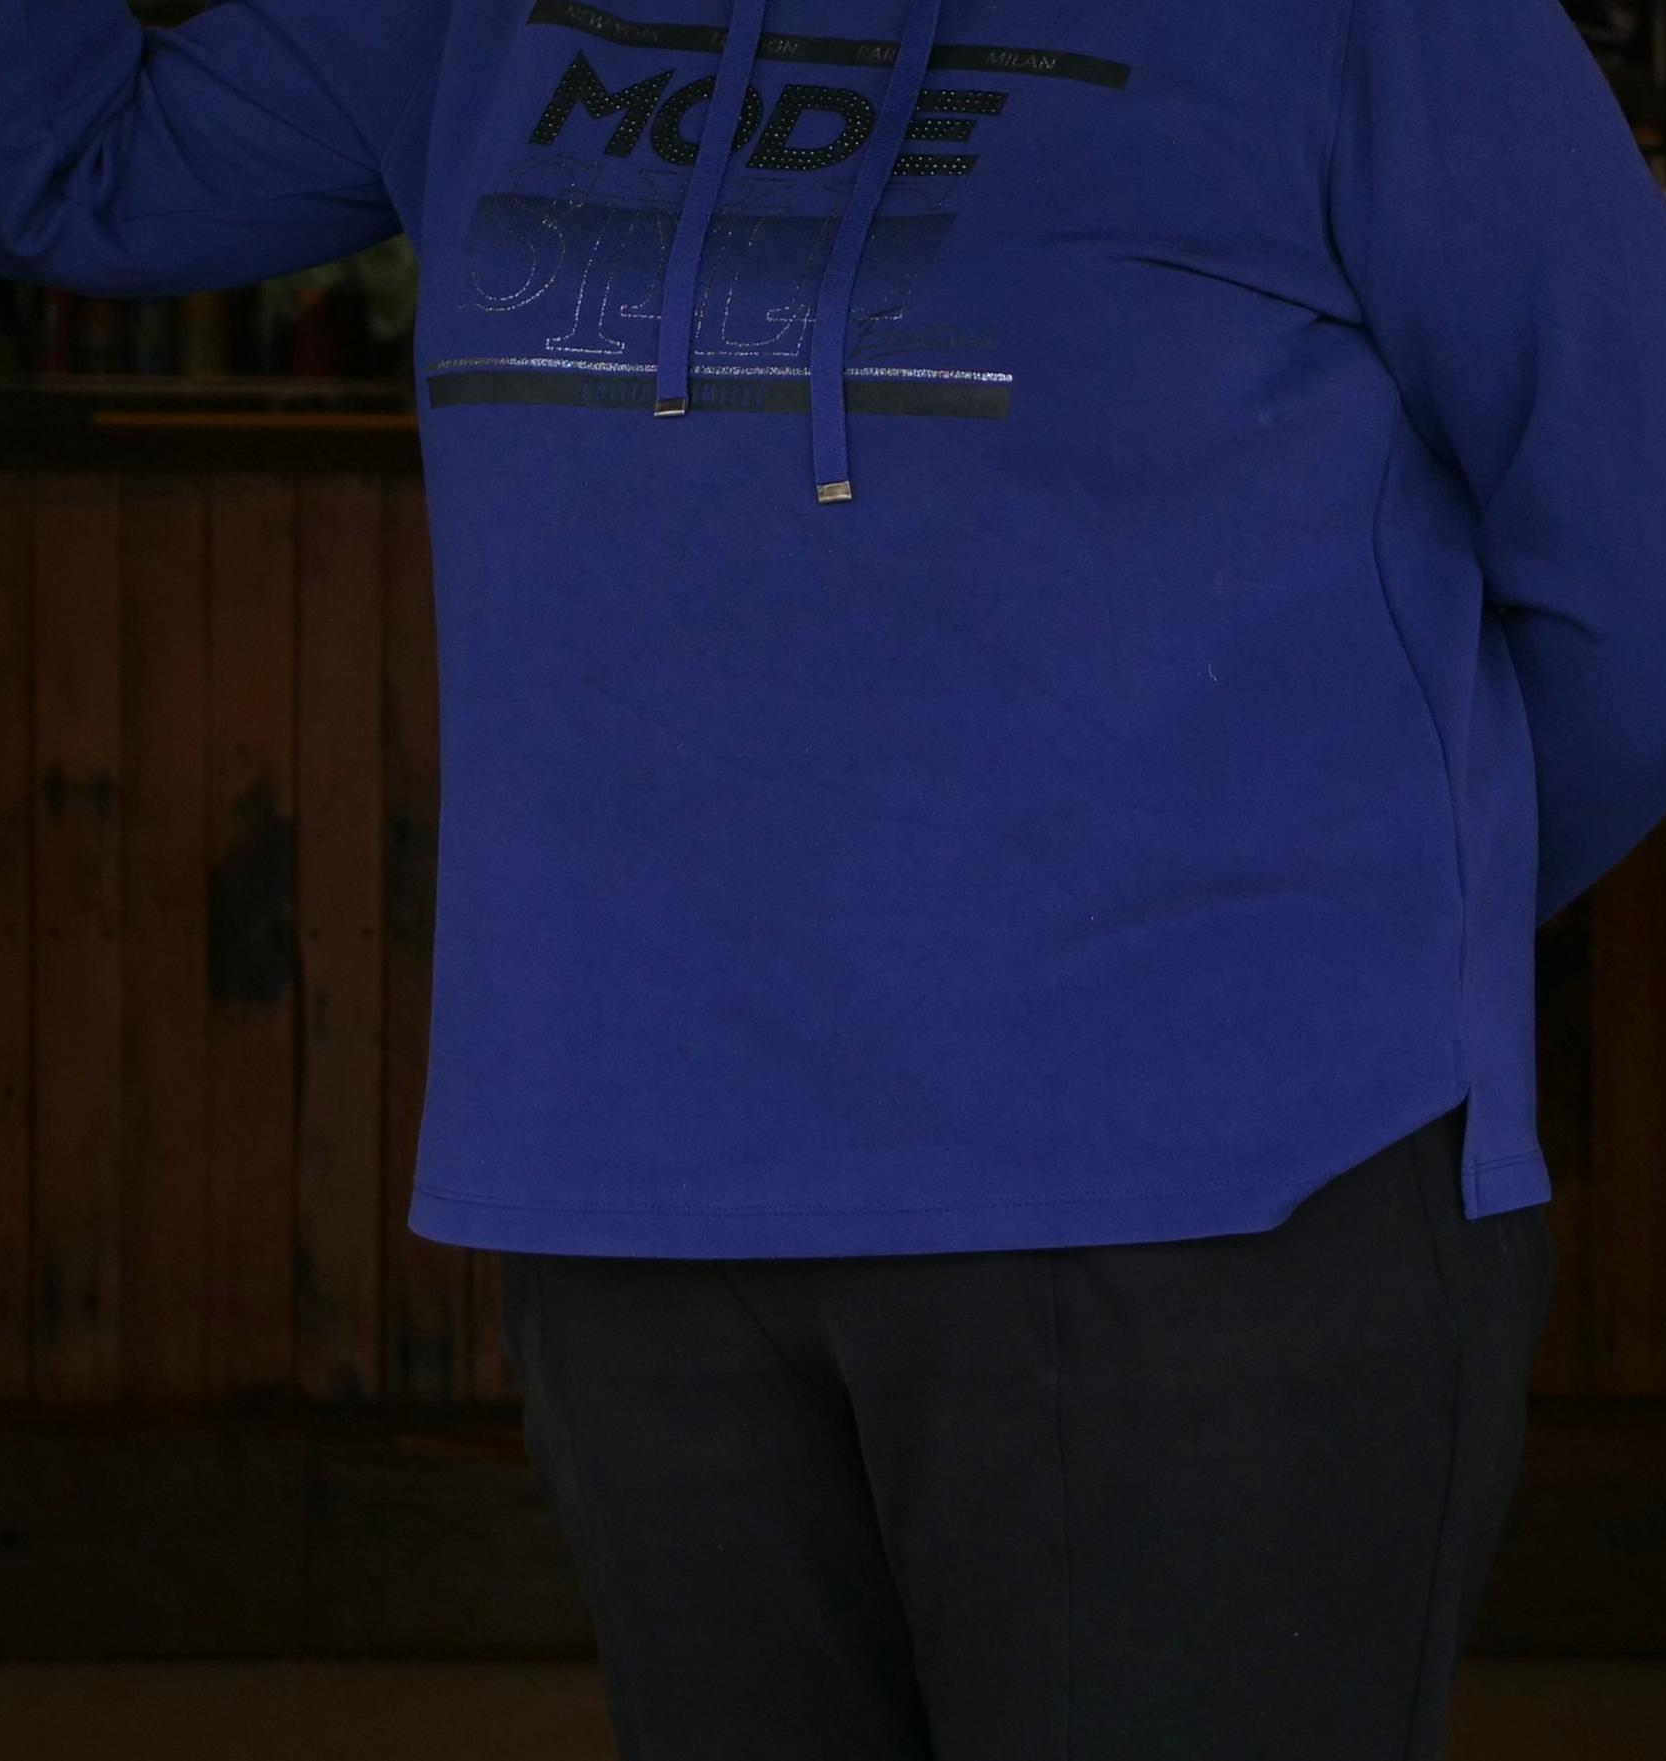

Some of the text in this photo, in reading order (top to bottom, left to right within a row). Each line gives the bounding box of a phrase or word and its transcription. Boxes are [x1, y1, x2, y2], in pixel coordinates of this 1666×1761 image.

[564, 4, 610, 29] NEW
[710, 31, 799, 55] LOON
[985, 50, 1057, 71] MILAN
[528, 49, 1009, 176] MODE
